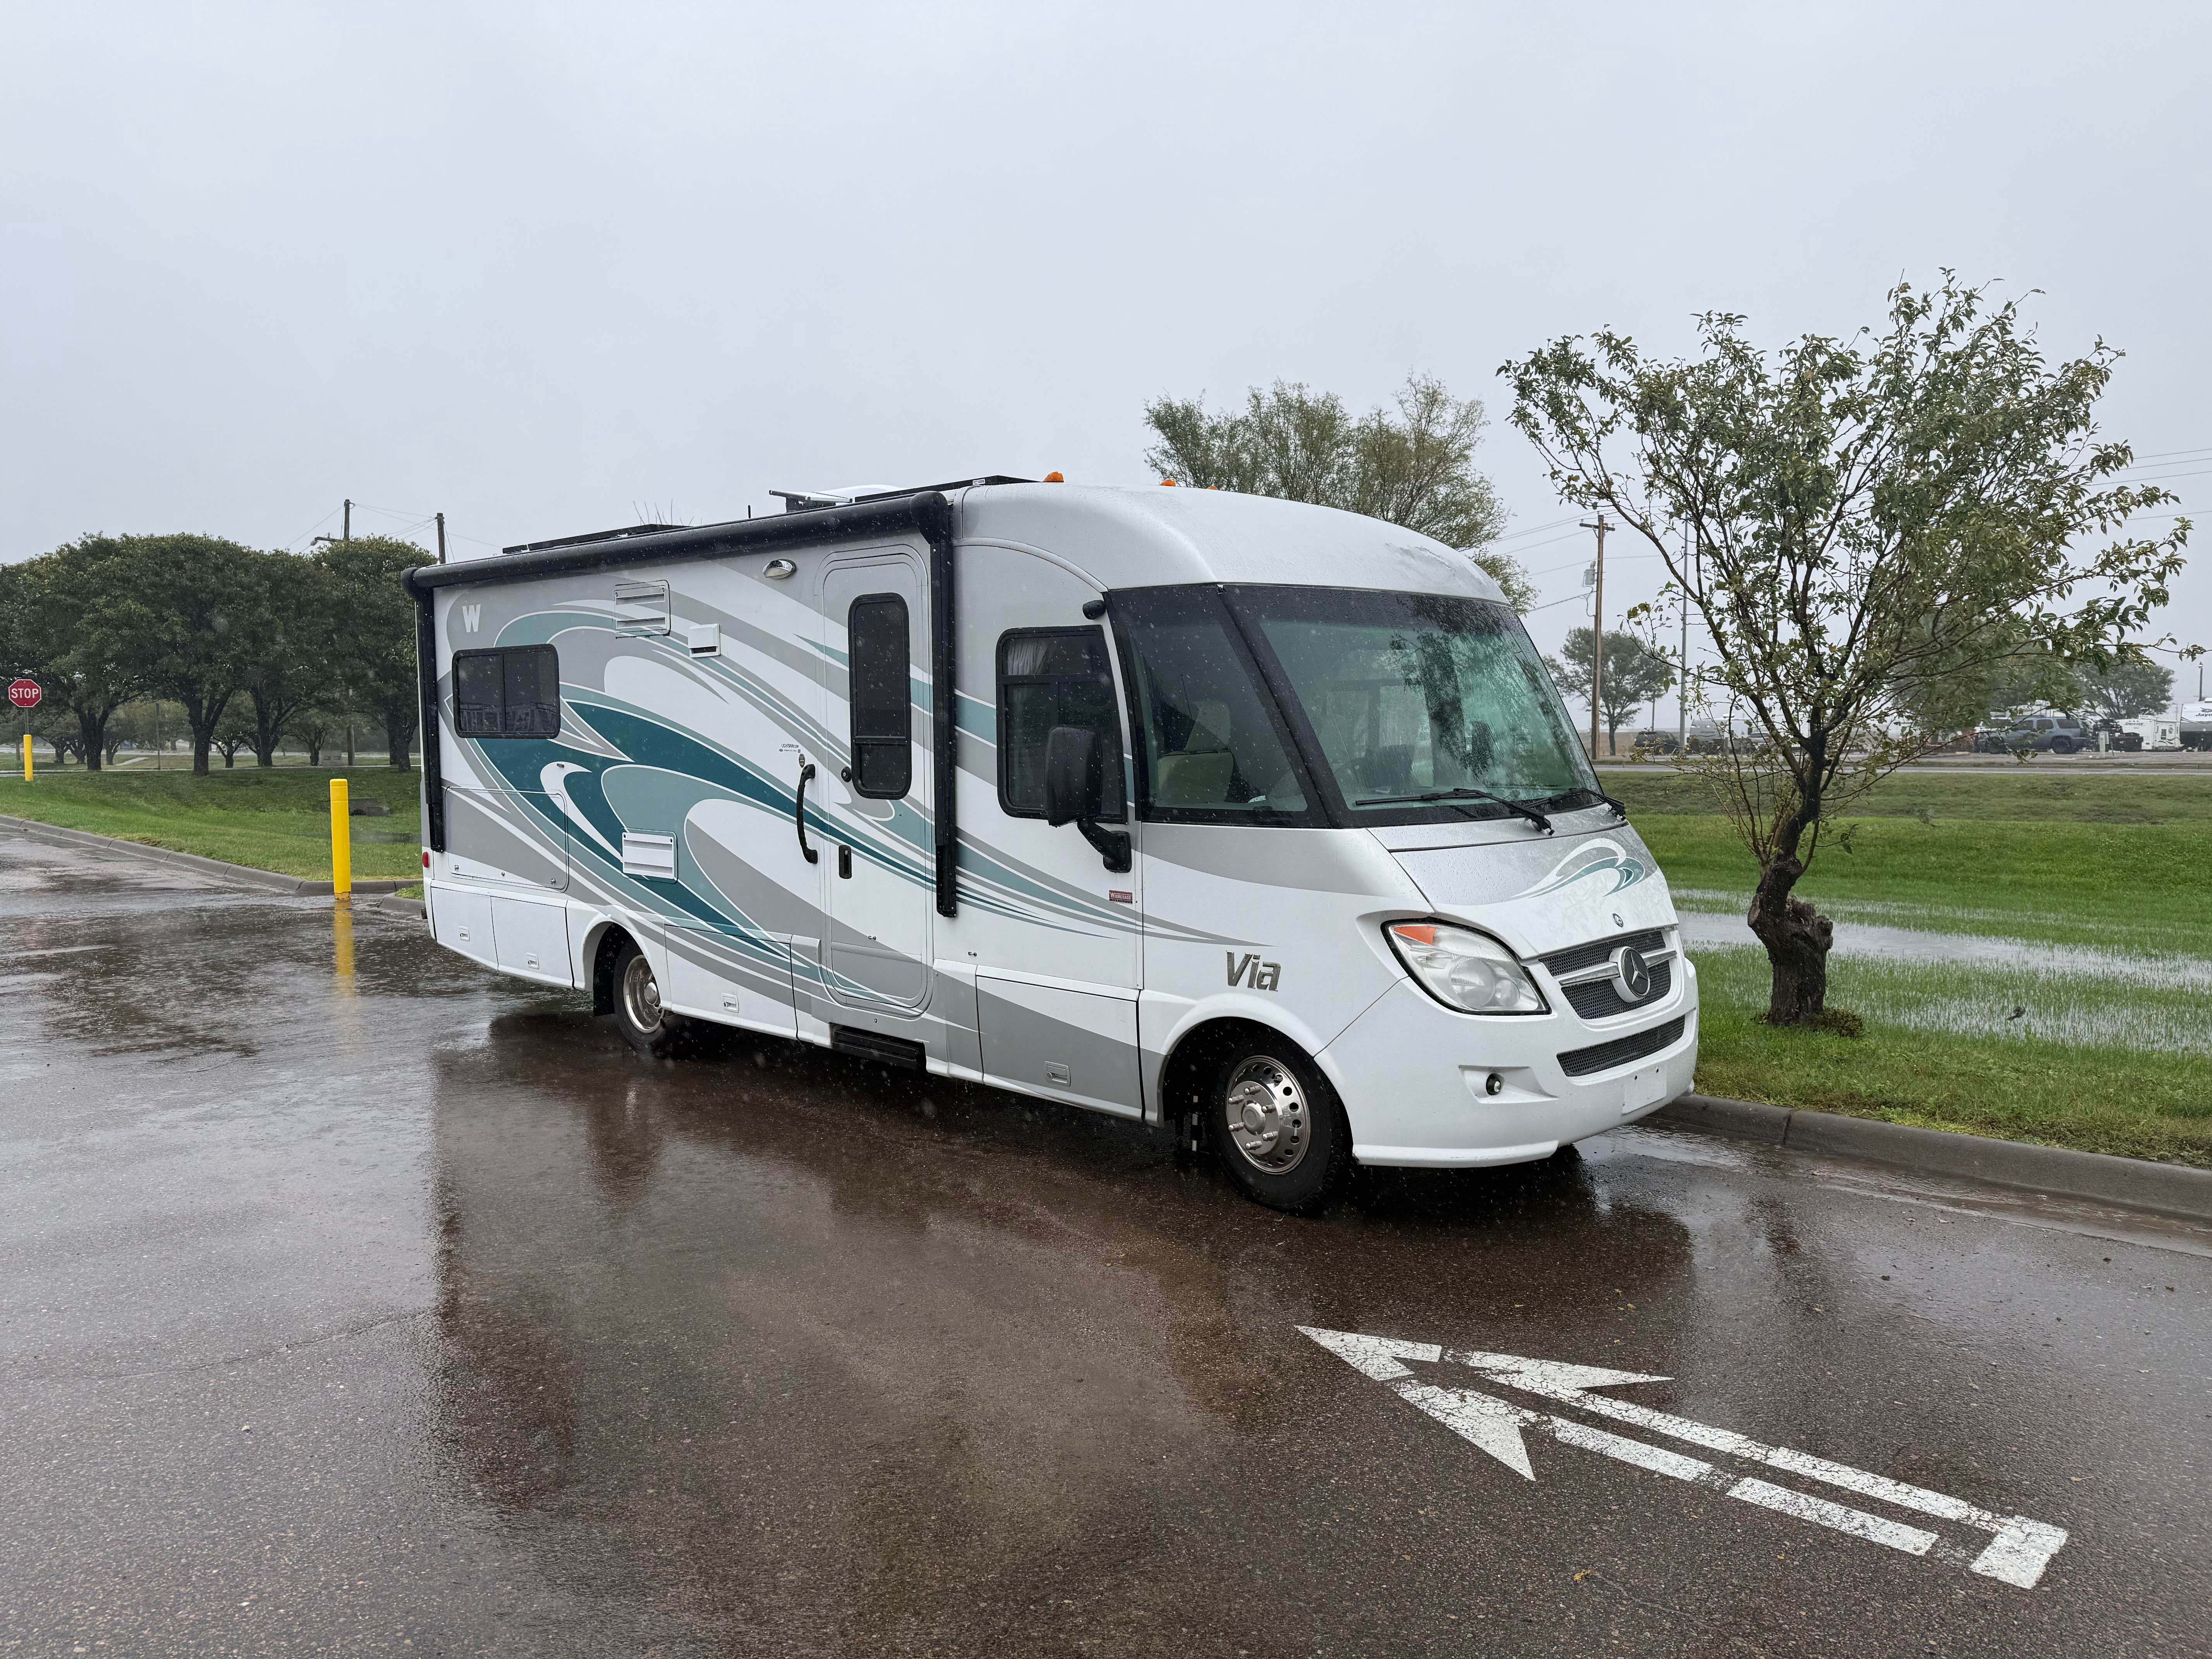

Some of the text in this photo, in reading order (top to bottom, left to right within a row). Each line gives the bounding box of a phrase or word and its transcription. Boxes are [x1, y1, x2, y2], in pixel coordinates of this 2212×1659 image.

[462, 604, 481, 632] W
[11, 688, 39, 699] STOP
[1226, 950, 1281, 991] Via
